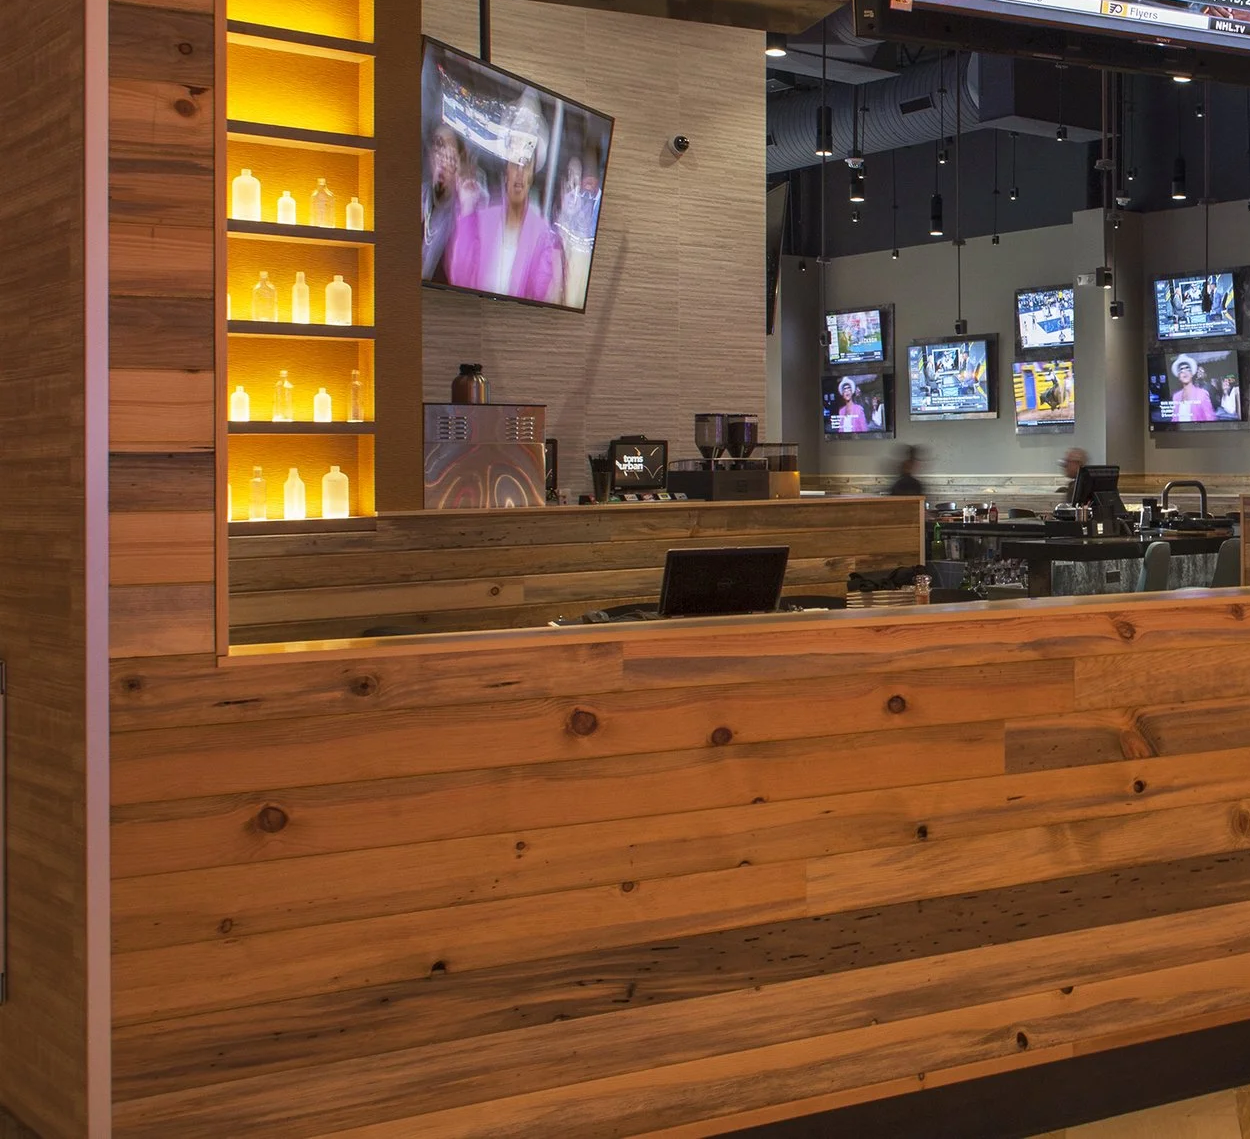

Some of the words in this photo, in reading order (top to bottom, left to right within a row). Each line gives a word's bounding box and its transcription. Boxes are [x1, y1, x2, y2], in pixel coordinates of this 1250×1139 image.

[1129, 6, 1159, 21] Flyers
[1215, 20, 1246, 34] NHL.TV
[623, 455, 644, 463] toms
[619, 463, 644, 471] urban
